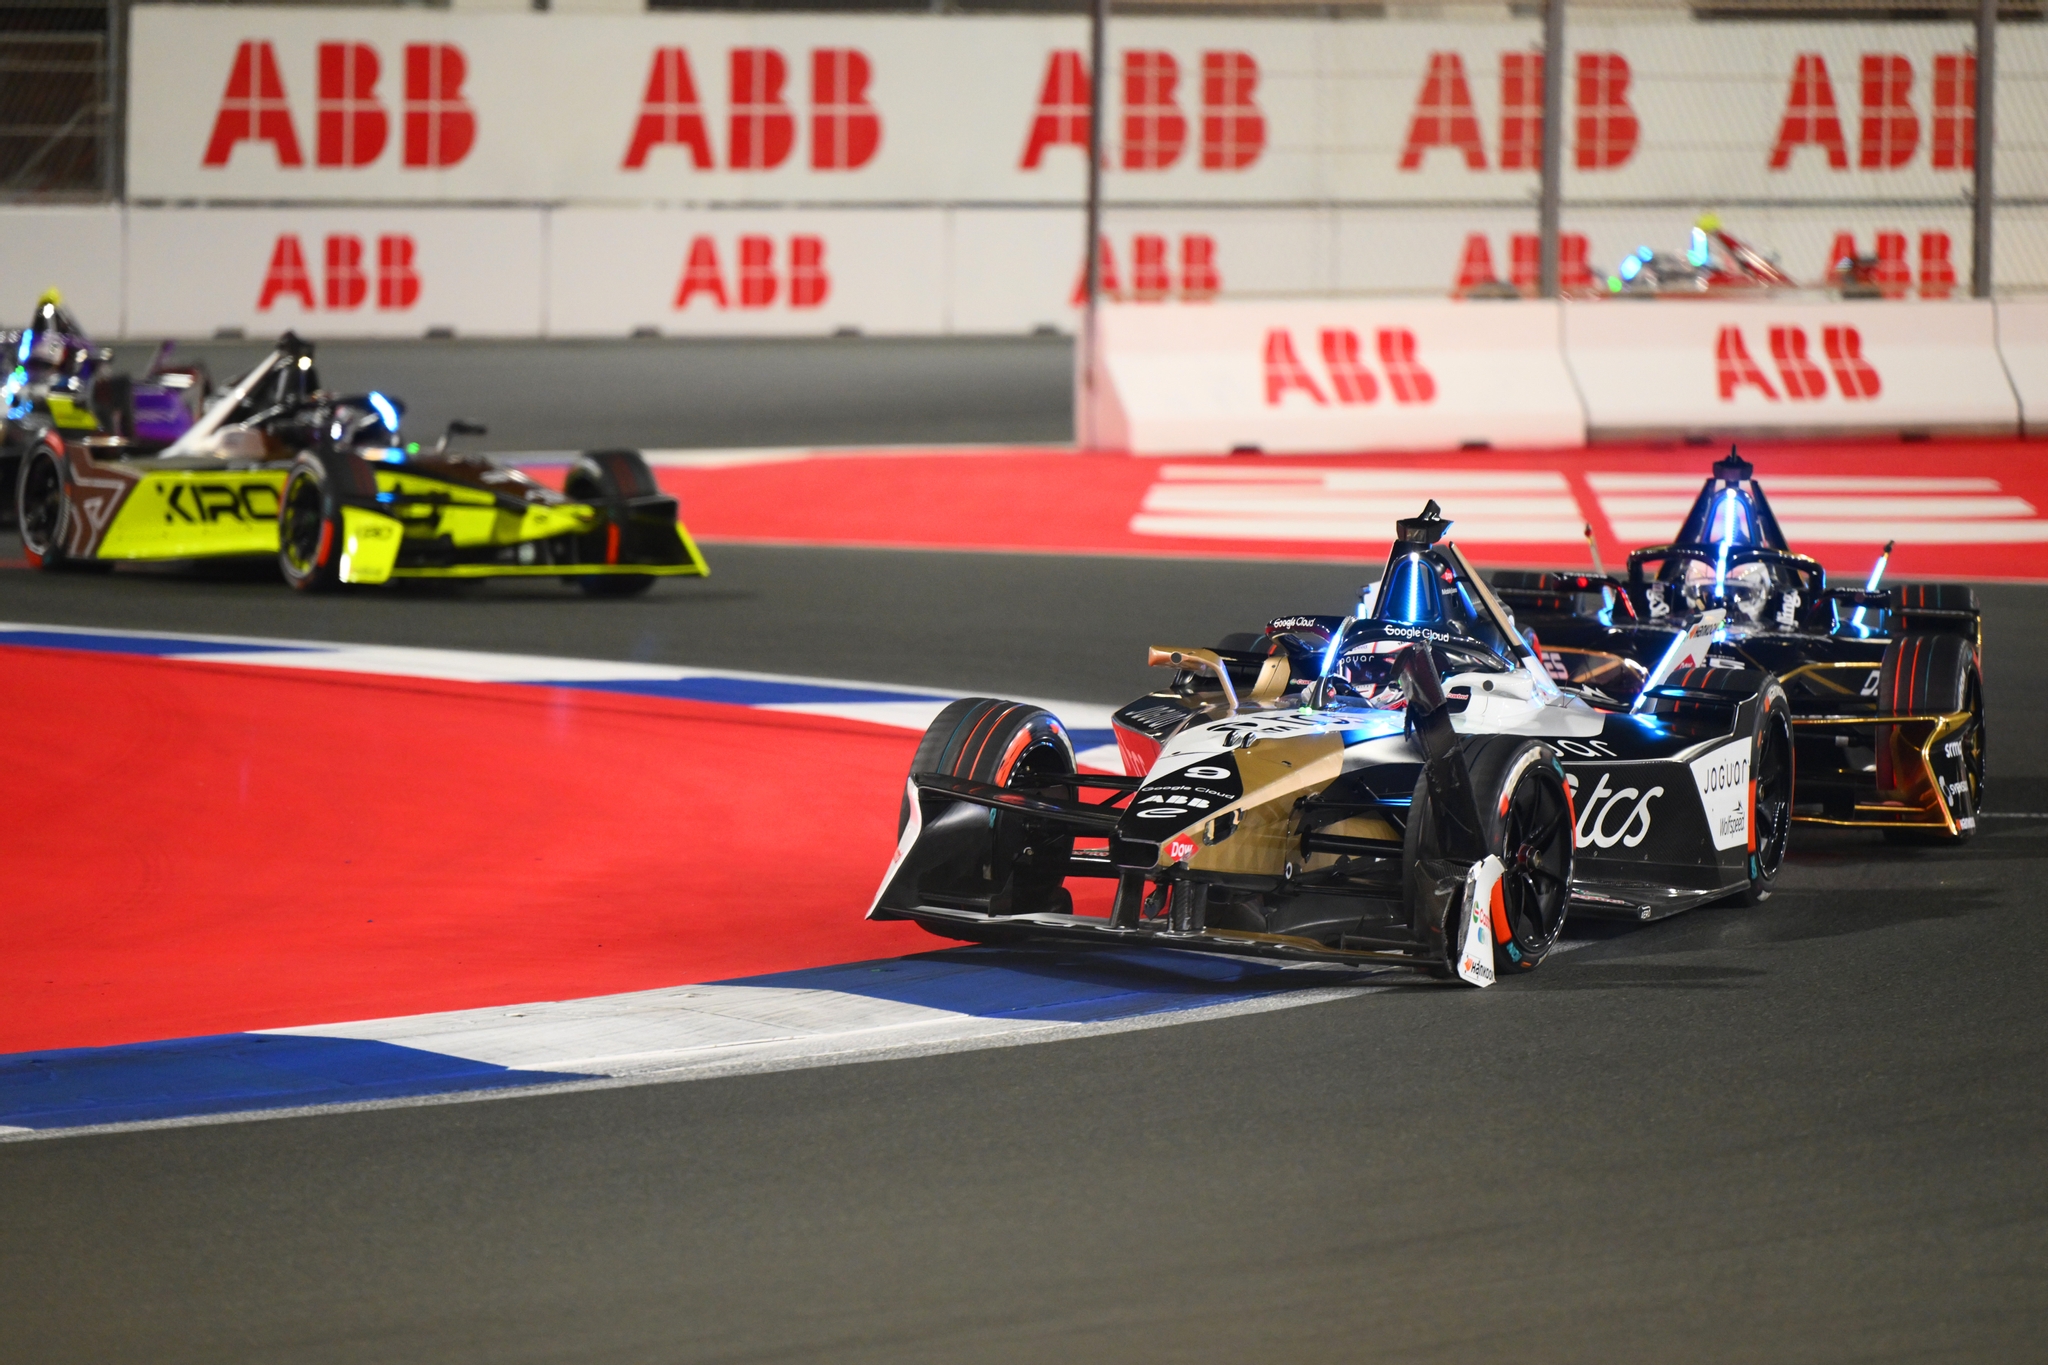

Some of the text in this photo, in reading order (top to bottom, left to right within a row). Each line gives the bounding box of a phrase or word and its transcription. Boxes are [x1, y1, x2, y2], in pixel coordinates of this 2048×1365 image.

[202, 40, 478, 169] ABB
[620, 46, 884, 171] ABB
[1018, 49, 1268, 171] ABB
[1398, 51, 1641, 171] ABB
[257, 234, 422, 312] ABB
[673, 234, 832, 311] ABB
[1070, 233, 1222, 304] ABB
[1261, 326, 1438, 407] ABB
[1714, 324, 1882, 402] ABB
[156, 483, 281, 524] KIRO
[1384, 624, 1450, 642] Google Cloud
[1137, 794, 1211, 809] ABB
[1183, 766, 1231, 780] 9
[1194, 786, 1236, 800] Cloud
[1575, 772, 1665, 849] tcs
[1170, 841, 1194, 858] Dow
